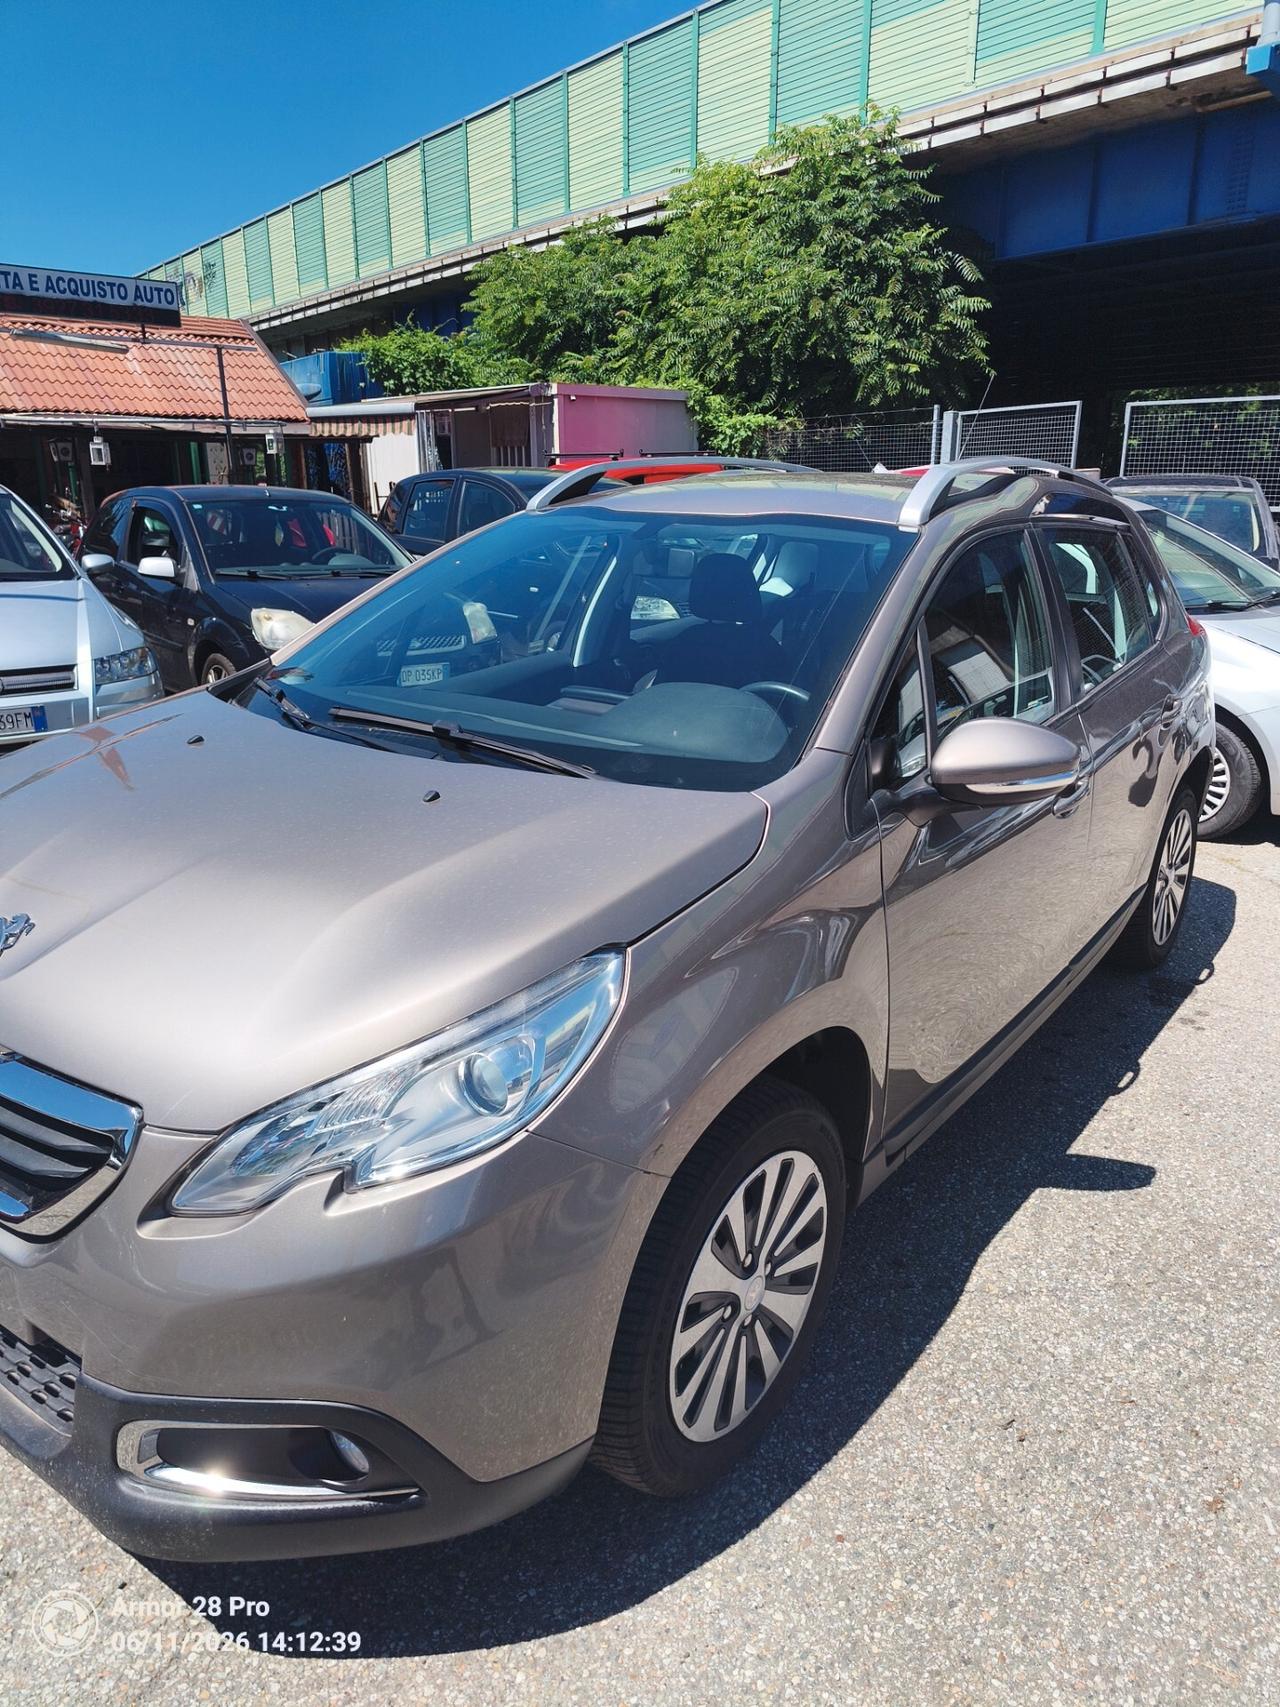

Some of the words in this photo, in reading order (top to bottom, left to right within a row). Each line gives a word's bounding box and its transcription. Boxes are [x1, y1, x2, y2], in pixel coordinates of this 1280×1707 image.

[28, 272, 40, 292] E
[45, 275, 128, 301] ACQUISTO
[133, 284, 175, 305] AUTO
